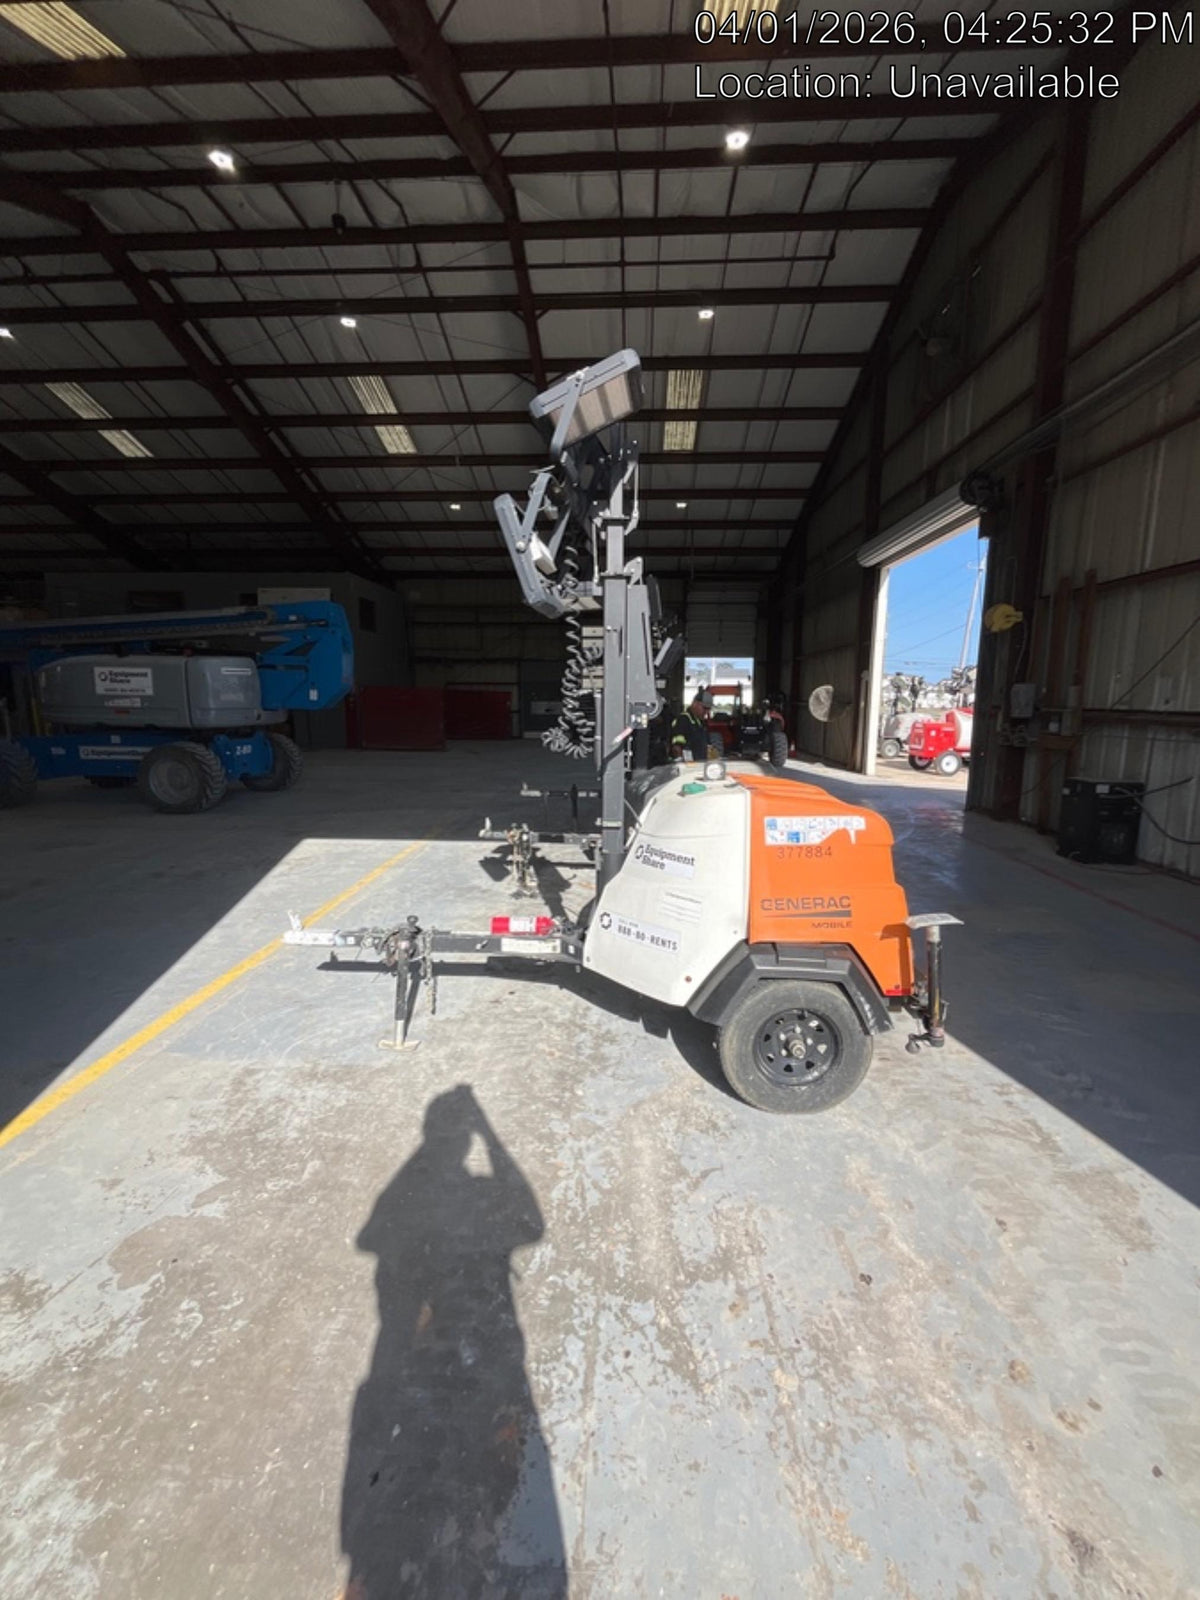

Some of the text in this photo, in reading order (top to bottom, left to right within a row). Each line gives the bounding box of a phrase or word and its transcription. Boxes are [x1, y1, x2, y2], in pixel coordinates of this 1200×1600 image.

[644, 843, 696, 867] Equipment
[776, 845, 833, 860] 377884
[641, 854, 666, 870] Share
[760, 895, 852, 912] GENERAC
[811, 920, 853, 930] MOBILE
